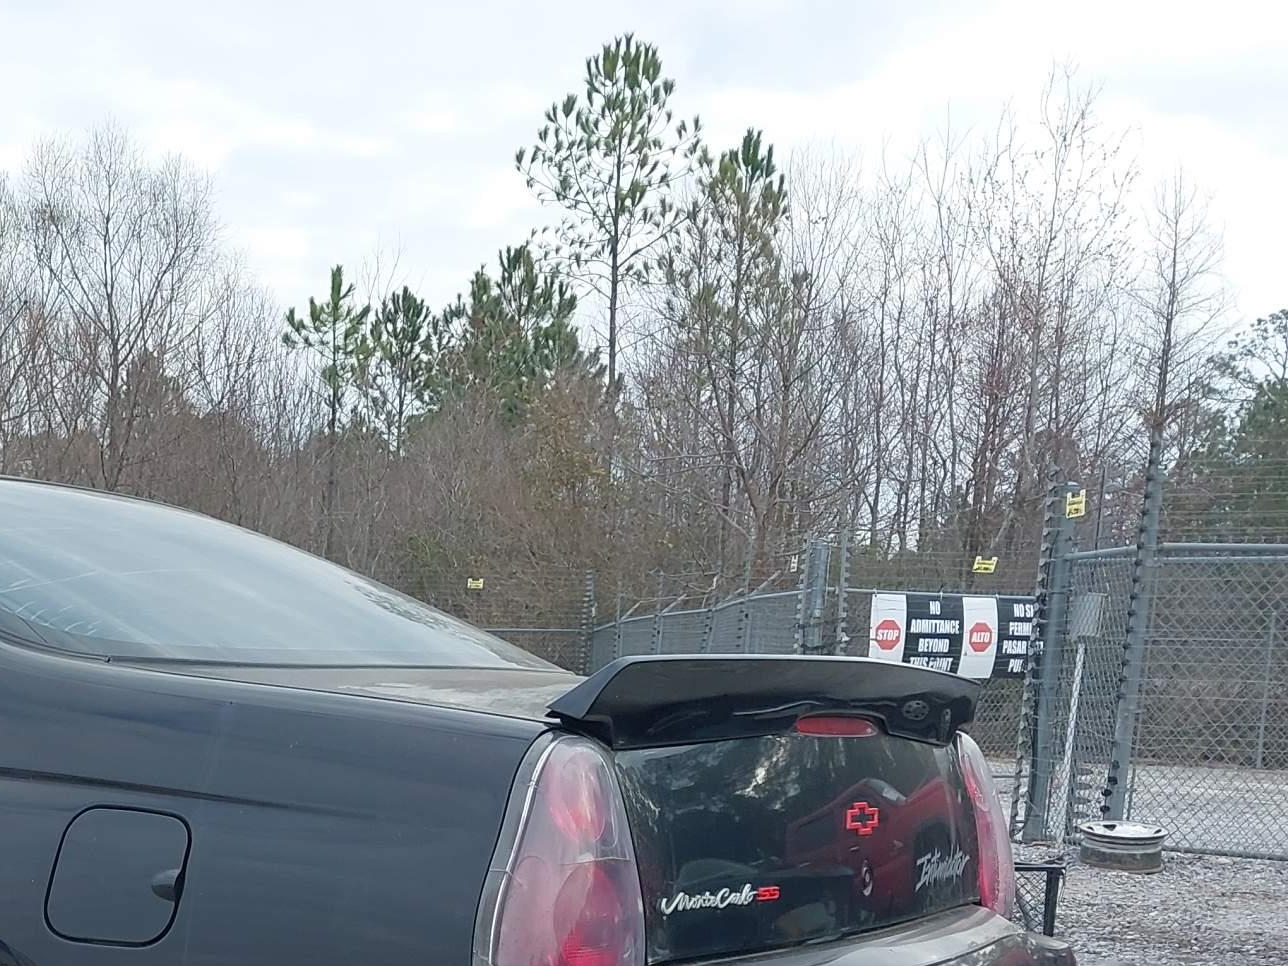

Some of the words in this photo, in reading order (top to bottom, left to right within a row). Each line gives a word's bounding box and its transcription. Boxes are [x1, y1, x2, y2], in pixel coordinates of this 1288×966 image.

[929, 600, 941, 615] NO
[1013, 603, 1025, 618] NO
[910, 618, 960, 634] ADMITTANCE
[876, 629, 899, 641] STOP
[971, 631, 991, 643] ALTO
[917, 638, 950, 653] BEYOND
[1002, 639, 1027, 655] PASAR
[909, 656, 929, 668] THIS
[928, 656, 954, 673] POINT
[757, 885, 781, 901] SS
